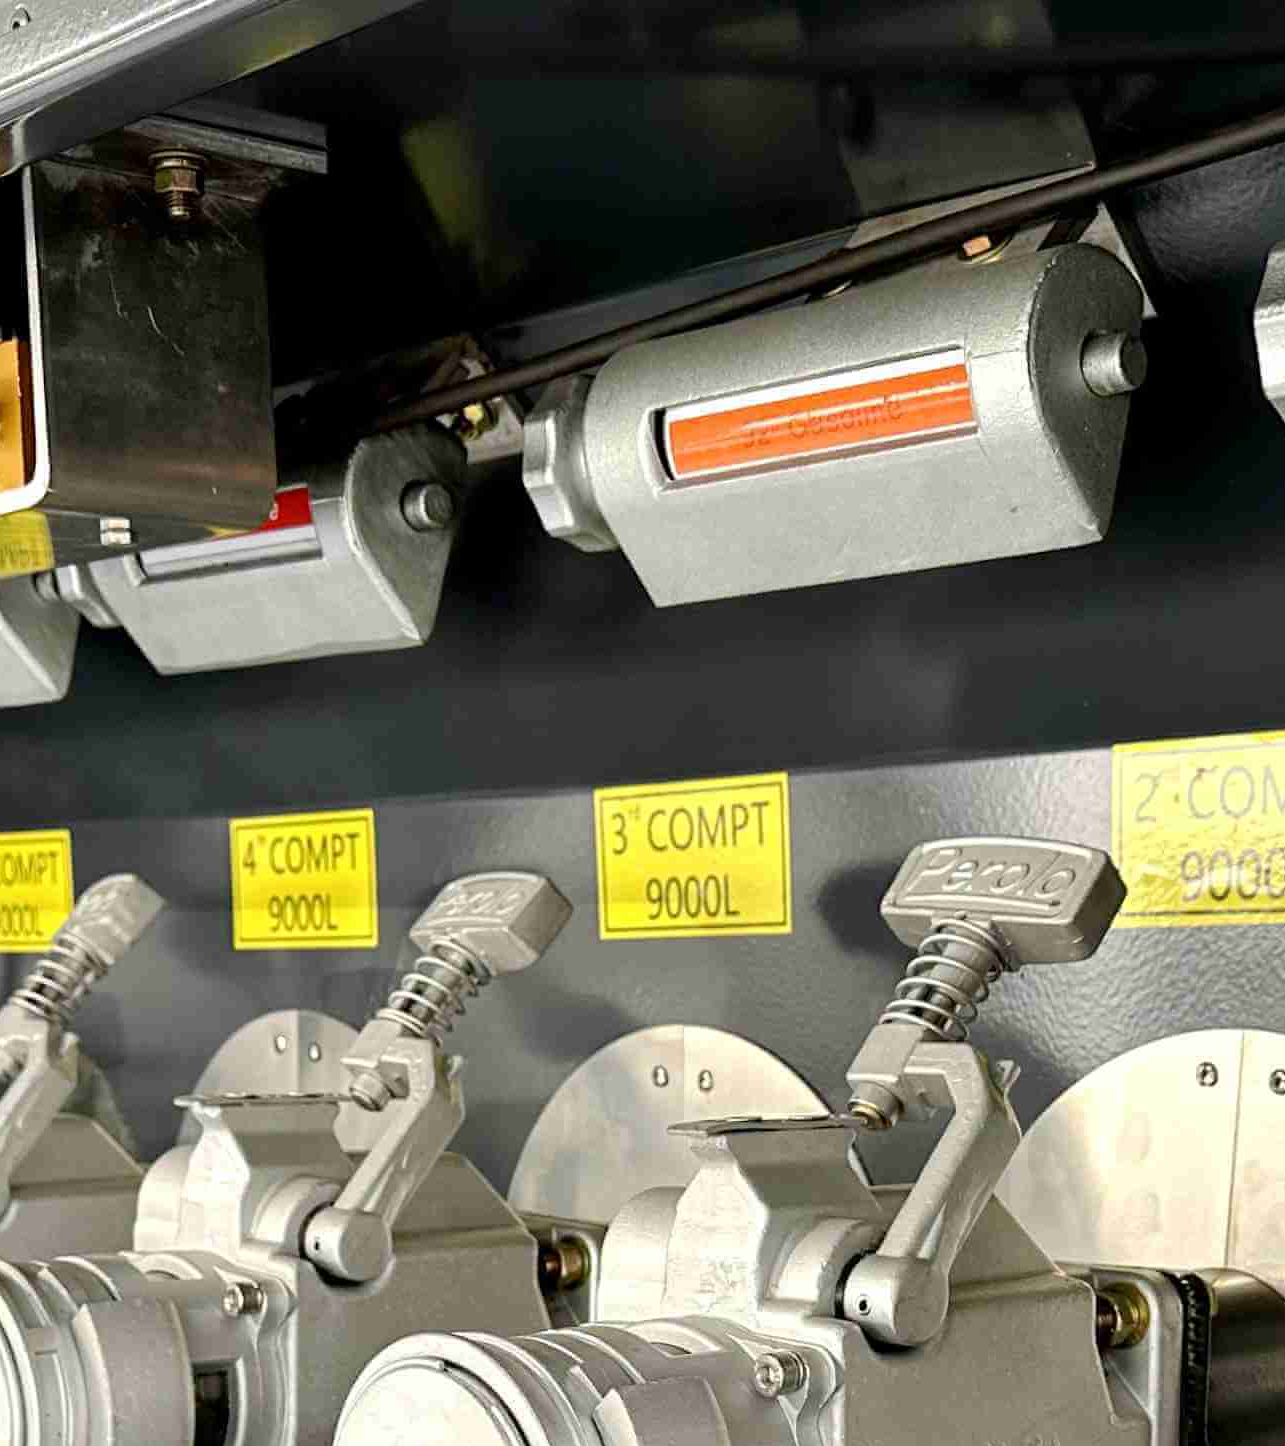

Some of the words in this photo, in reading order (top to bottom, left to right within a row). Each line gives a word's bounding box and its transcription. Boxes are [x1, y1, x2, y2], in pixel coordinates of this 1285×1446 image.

[647, 801, 770, 852] COMPT
[268, 831, 362, 876] COMPT
[267, 892, 339, 933] 9000L
[645, 873, 742, 921] 9000L
